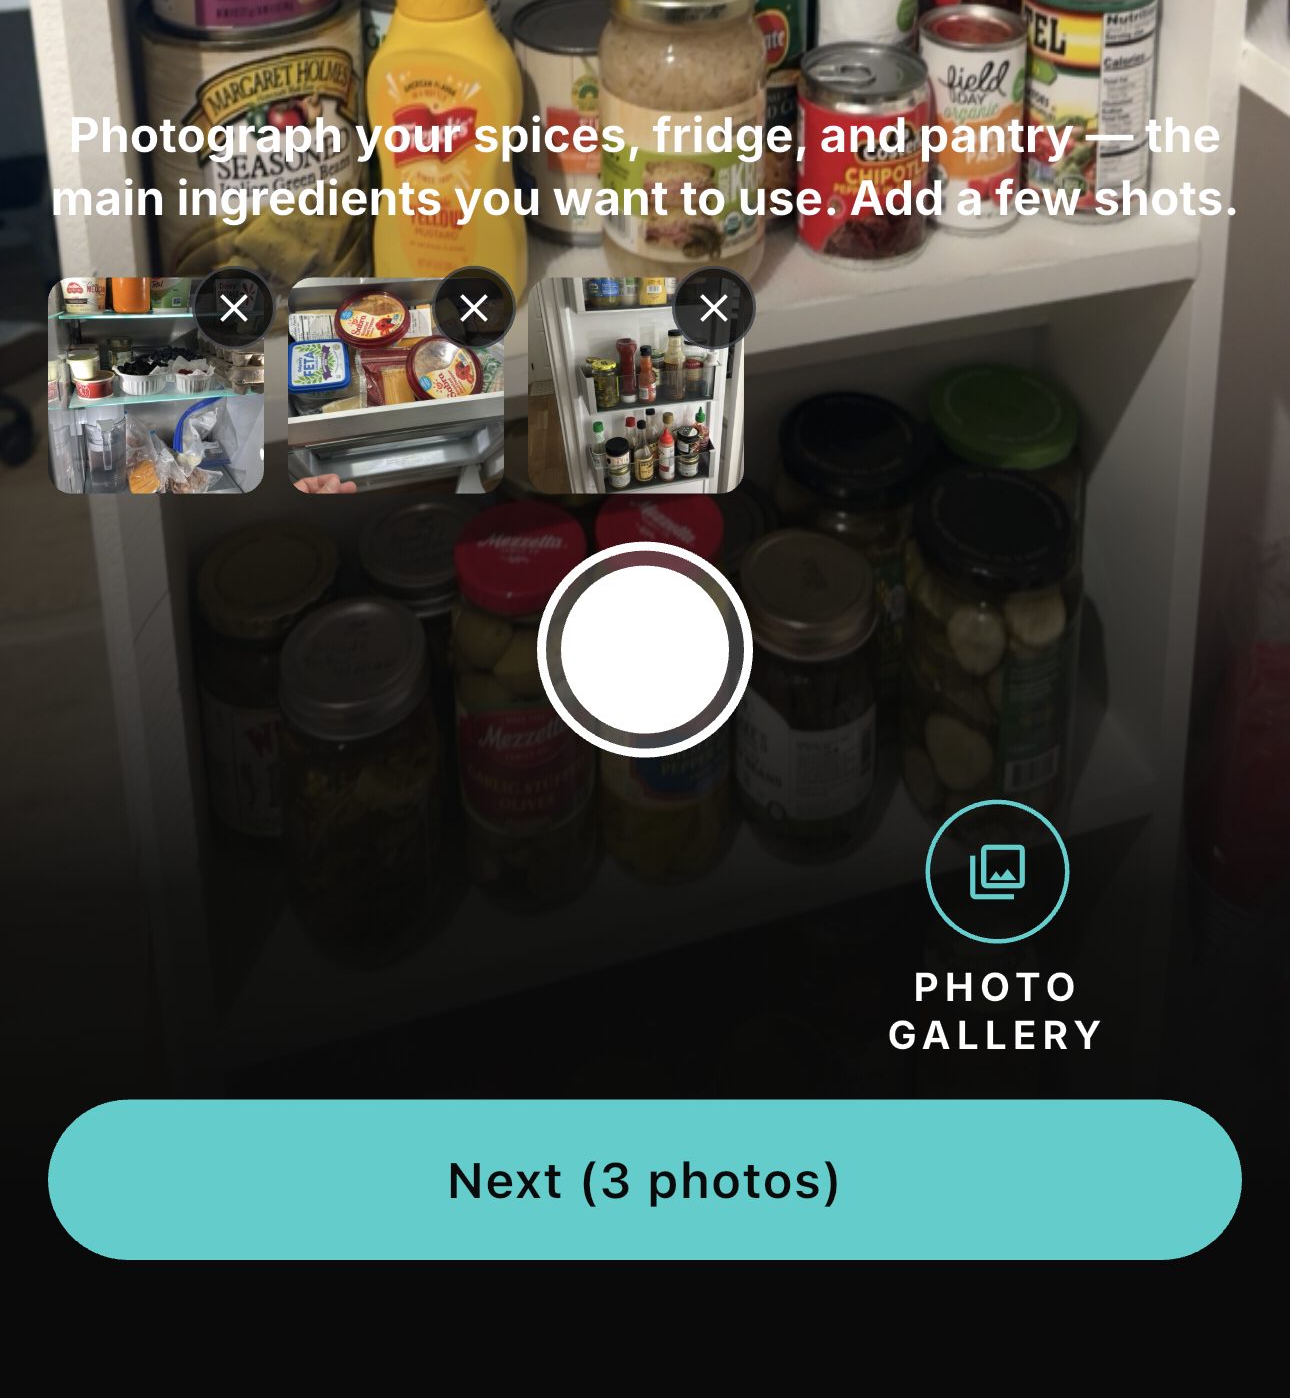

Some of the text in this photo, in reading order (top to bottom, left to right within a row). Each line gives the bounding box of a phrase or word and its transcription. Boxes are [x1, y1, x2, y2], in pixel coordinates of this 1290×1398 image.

[1103, 52, 1146, 68] Calories
[206, 65, 293, 116] MARGARET
[297, 58, 349, 84] HOLMES
[272, 171, 316, 193] Green
[351, 315, 367, 335] Sabra
[303, 352, 315, 377] FETA
[477, 532, 564, 551] Mezzetta
